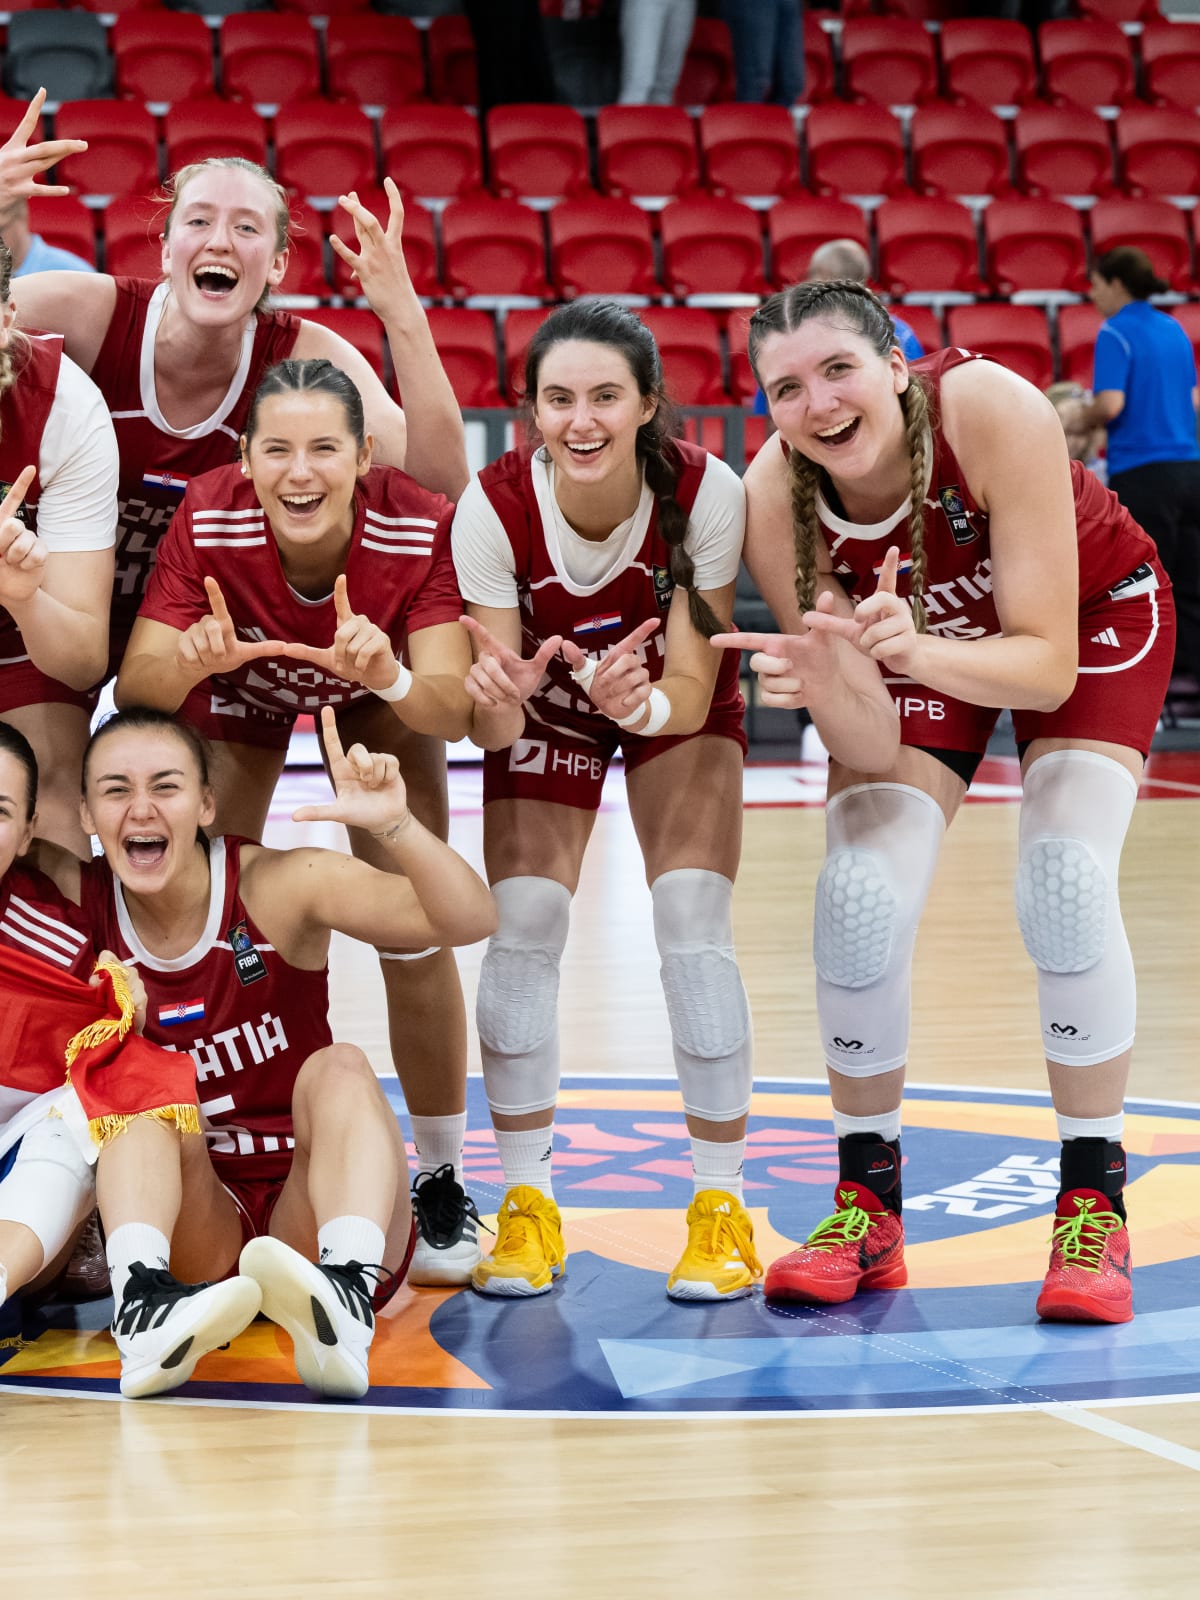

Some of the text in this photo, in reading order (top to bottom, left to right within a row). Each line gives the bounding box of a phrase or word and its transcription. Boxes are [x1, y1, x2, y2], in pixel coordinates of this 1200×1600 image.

[551, 749, 602, 780] HPB
[238, 954, 259, 970] FIBA
[901, 1154, 1062, 1220] 2025
